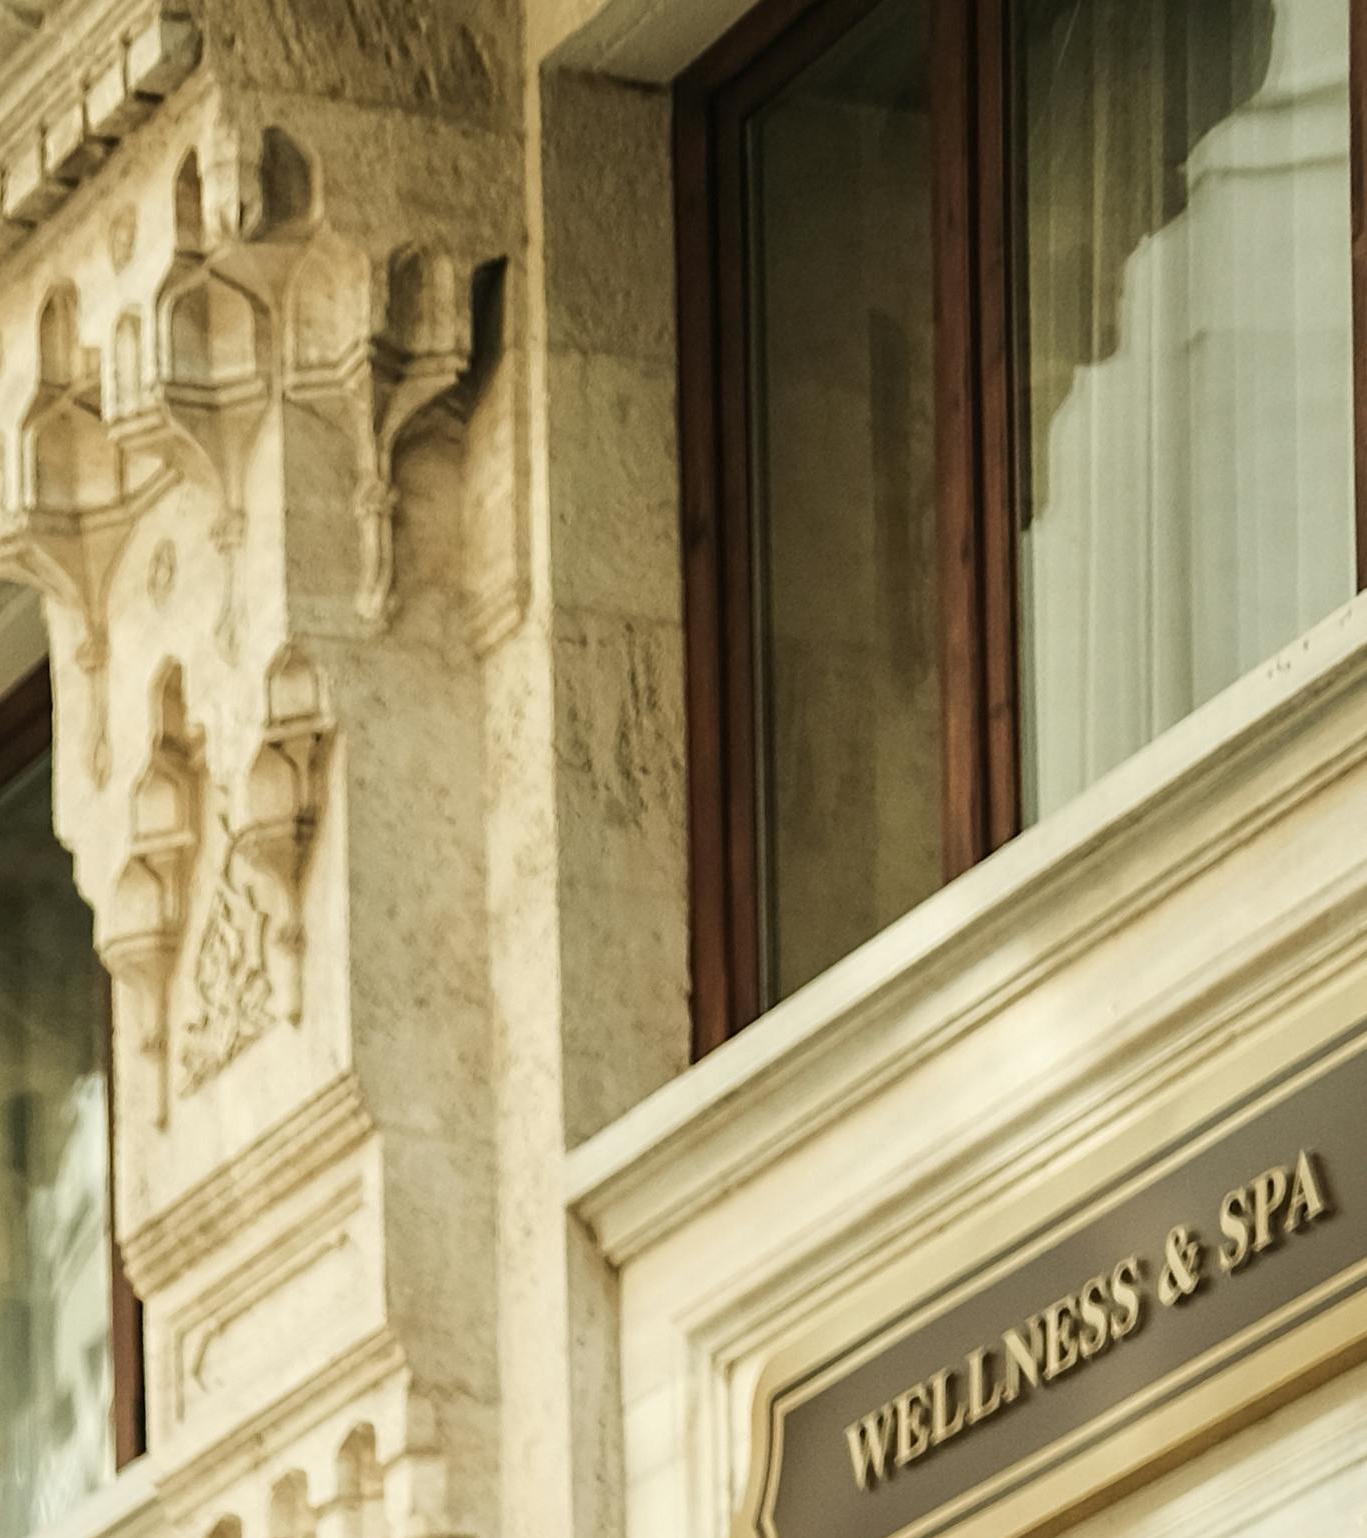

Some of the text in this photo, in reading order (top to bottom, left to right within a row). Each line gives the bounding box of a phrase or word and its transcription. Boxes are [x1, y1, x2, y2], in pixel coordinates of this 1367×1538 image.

[843, 1148, 1327, 1490] WELLNESS & SPA
